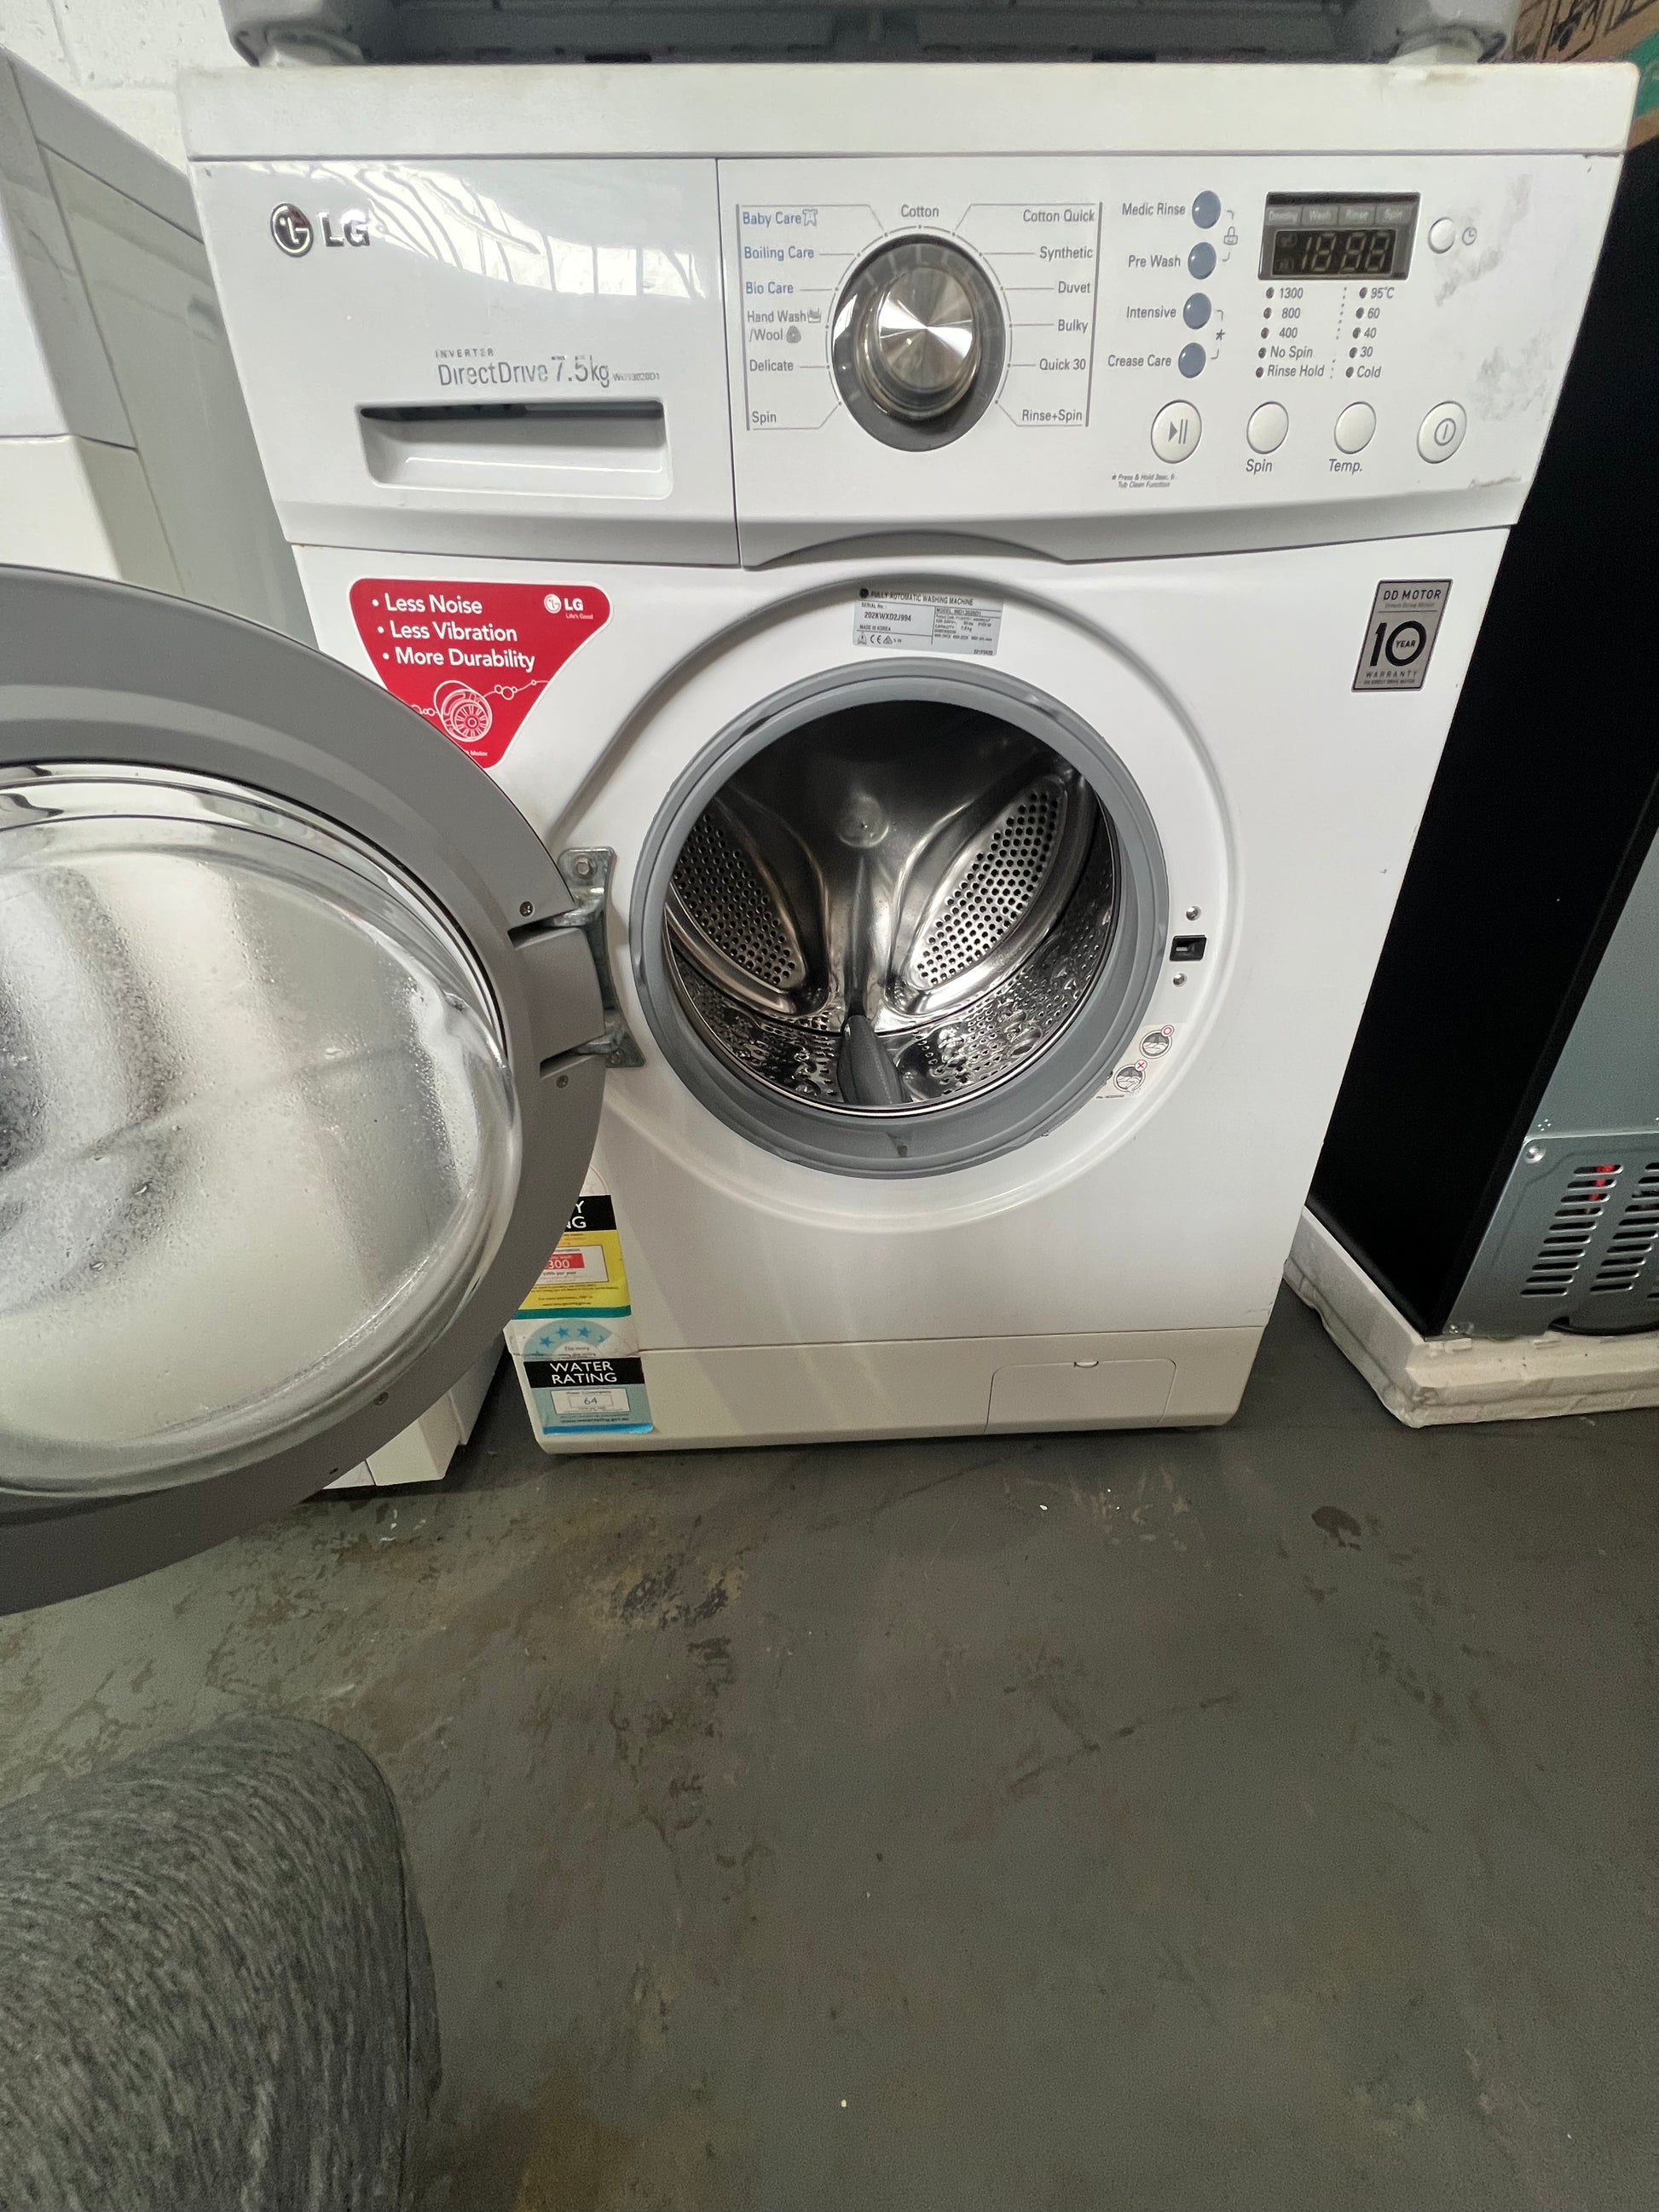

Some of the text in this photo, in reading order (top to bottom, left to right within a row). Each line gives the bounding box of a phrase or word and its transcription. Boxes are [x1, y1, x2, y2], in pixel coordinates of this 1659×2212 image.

[900, 205, 939, 218] Cotton
[1122, 202, 1186, 216] Medic Rinse
[743, 212, 801, 228] Baby Care
[1023, 210, 1095, 222] Cotton Quick
[320, 211, 371, 247] LG
[744, 246, 814, 262] Boiling Care
[1039, 246, 1093, 261] Synthetic
[1128, 255, 1182, 268] Pre Wash
[745, 282, 794, 294] Bio Care
[1058, 281, 1091, 294] Duvet
[1279, 287, 1304, 299] 1300
[747, 310, 806, 323] Hand Wash
[1126, 306, 1176, 319] Intensive
[1281, 308, 1301, 320] 800
[1367, 308, 1380, 320] 60
[1058, 319, 1089, 333] Bulky
[749, 329, 783, 342] /Wool
[1279, 327, 1298, 339] 400
[1364, 327, 1377, 339] 40
[436, 348, 494, 359] INVERTER
[1270, 346, 1314, 361] No Spin
[1360, 346, 1373, 358] 30
[749, 360, 794, 372] Delicate
[1038, 358, 1086, 373] Quick 30
[1107, 355, 1172, 367] Crease Care
[1267, 365, 1325, 378] Rinse Hold
[1356, 366, 1382, 378] Cold
[752, 411, 777, 425] Spin
[1022, 409, 1083, 424] Rinse+Spin
[1246, 459, 1274, 475] Spin
[1329, 459, 1363, 475] Temp.
[889, 592, 922, 601] AUTOMATIC
[922, 596, 948, 604] WASHING
[949, 598, 974, 606] MACHINE
[1384, 589, 1442, 601] DD MOTOR
[384, 592, 483, 615] Less Noise
[564, 598, 584, 611] LG
[390, 621, 517, 642] Less Vibration
[1370, 621, 1427, 667] 10
[395, 646, 535, 673] More Durability
[1366, 670, 1418, 679] WARRANTY
[548, 1259, 570, 1269] 300
[550, 1361, 614, 1372] WATER
[552, 1372, 617, 1384] RATING
